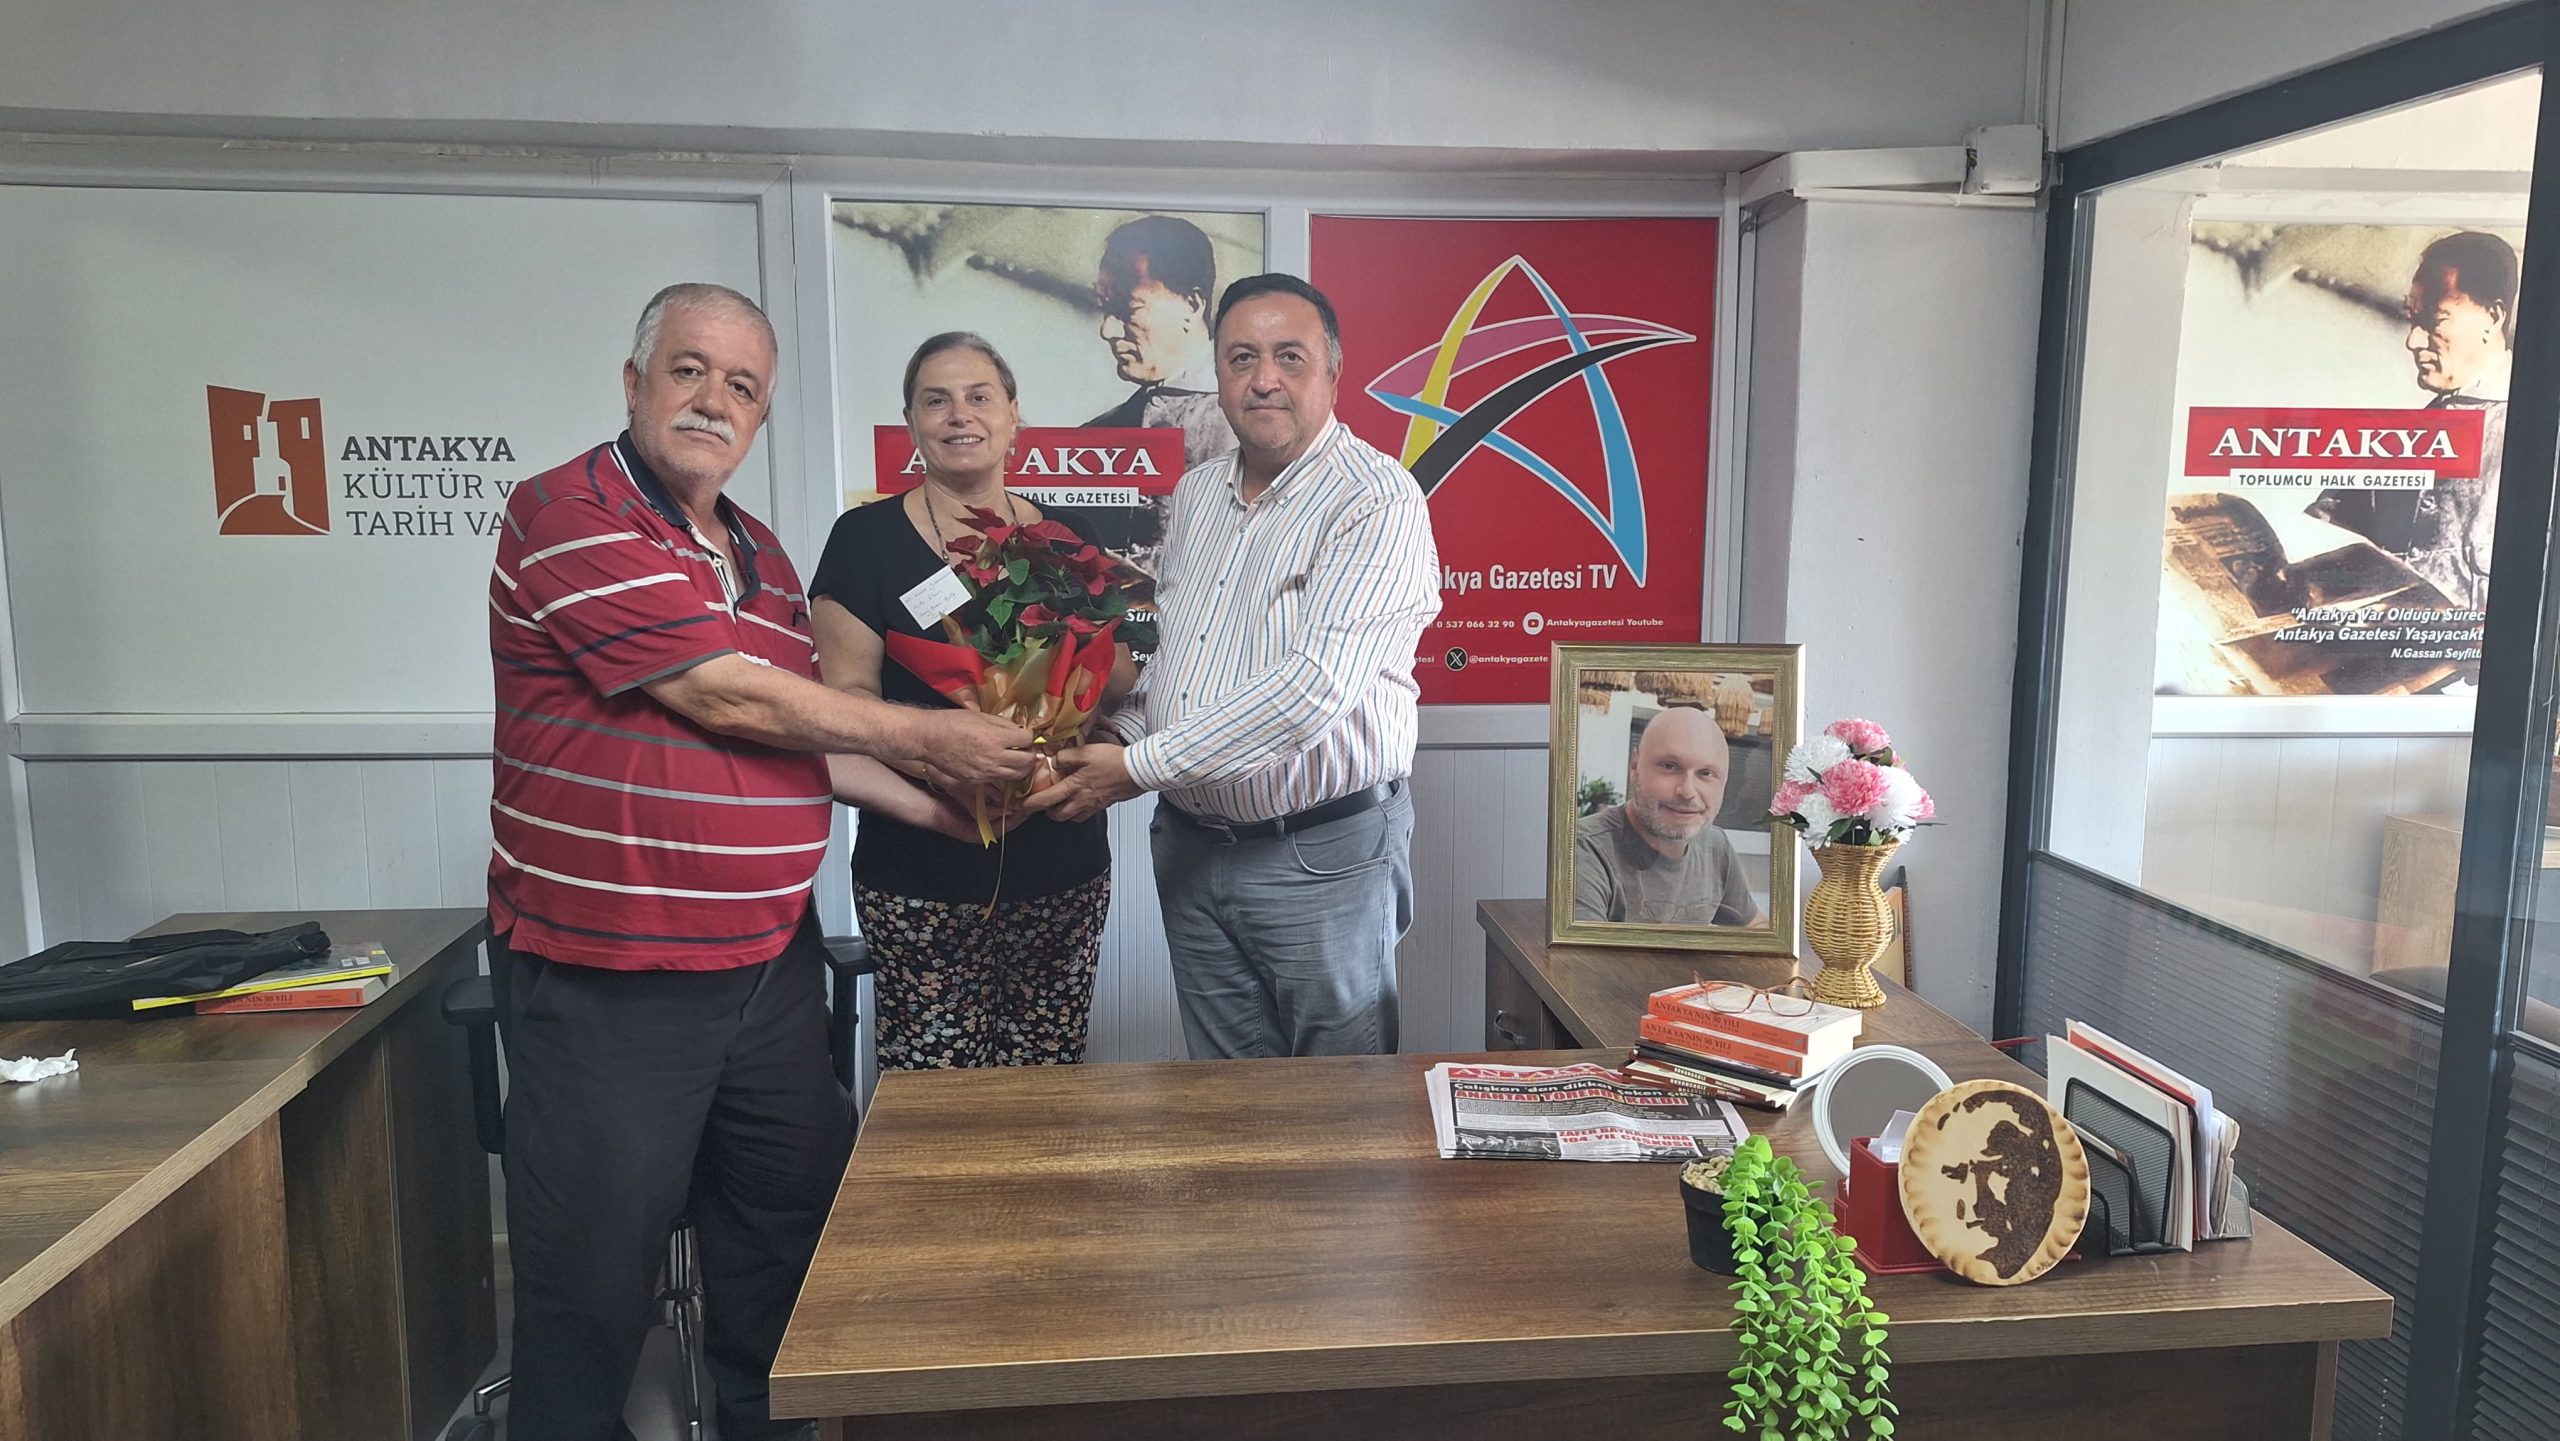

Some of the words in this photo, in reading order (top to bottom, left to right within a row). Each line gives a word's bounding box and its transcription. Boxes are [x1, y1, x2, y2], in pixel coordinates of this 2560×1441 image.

[341, 436, 515, 462] ANTAKYA
[2209, 427, 2459, 459] ANTAKYA
[900, 446, 1162, 476] AAKYA
[343, 468, 484, 499] KÜLTÜR
[2239, 474, 2313, 487] TOPLUMCU
[2320, 475, 2355, 487] HALK
[2363, 472, 2427, 488] GAZETESİ
[1065, 489, 1131, 504] GAZETESİ
[346, 505, 453, 536] TARİH
[1439, 564, 1483, 596] kya
[1489, 564, 1582, 590] Gazetesi
[1589, 564, 1618, 589] TV
[1436, 620, 1444, 629] 0
[1446, 620, 1464, 629] 537
[1466, 620, 1485, 629] 066
[1487, 620, 1500, 628] 32
[1502, 620, 1515, 628] 90
[1546, 618, 1624, 628] Antakyagazetesi
[1627, 618, 1664, 627] Youtube
[2360, 607, 2387, 621] Var
[2387, 606, 2440, 625] Olduğu
[2274, 627, 2335, 643] Antakya
[2338, 626, 2402, 641] Gazetesi
[2390, 648, 2443, 659] N.Gassan
[1654, 1000, 1711, 1022] ANTAKYA'NIN
[1712, 1015, 1722, 1024] 50
[1723, 1018, 1741, 1029] YILI
[1644, 1022, 1702, 1042] ANTAKYA'NIN
[1703, 1036, 1714, 1046] 50
[1714, 1039, 1732, 1050] YILI
[1563, 1081, 1612, 1090] dikkat
